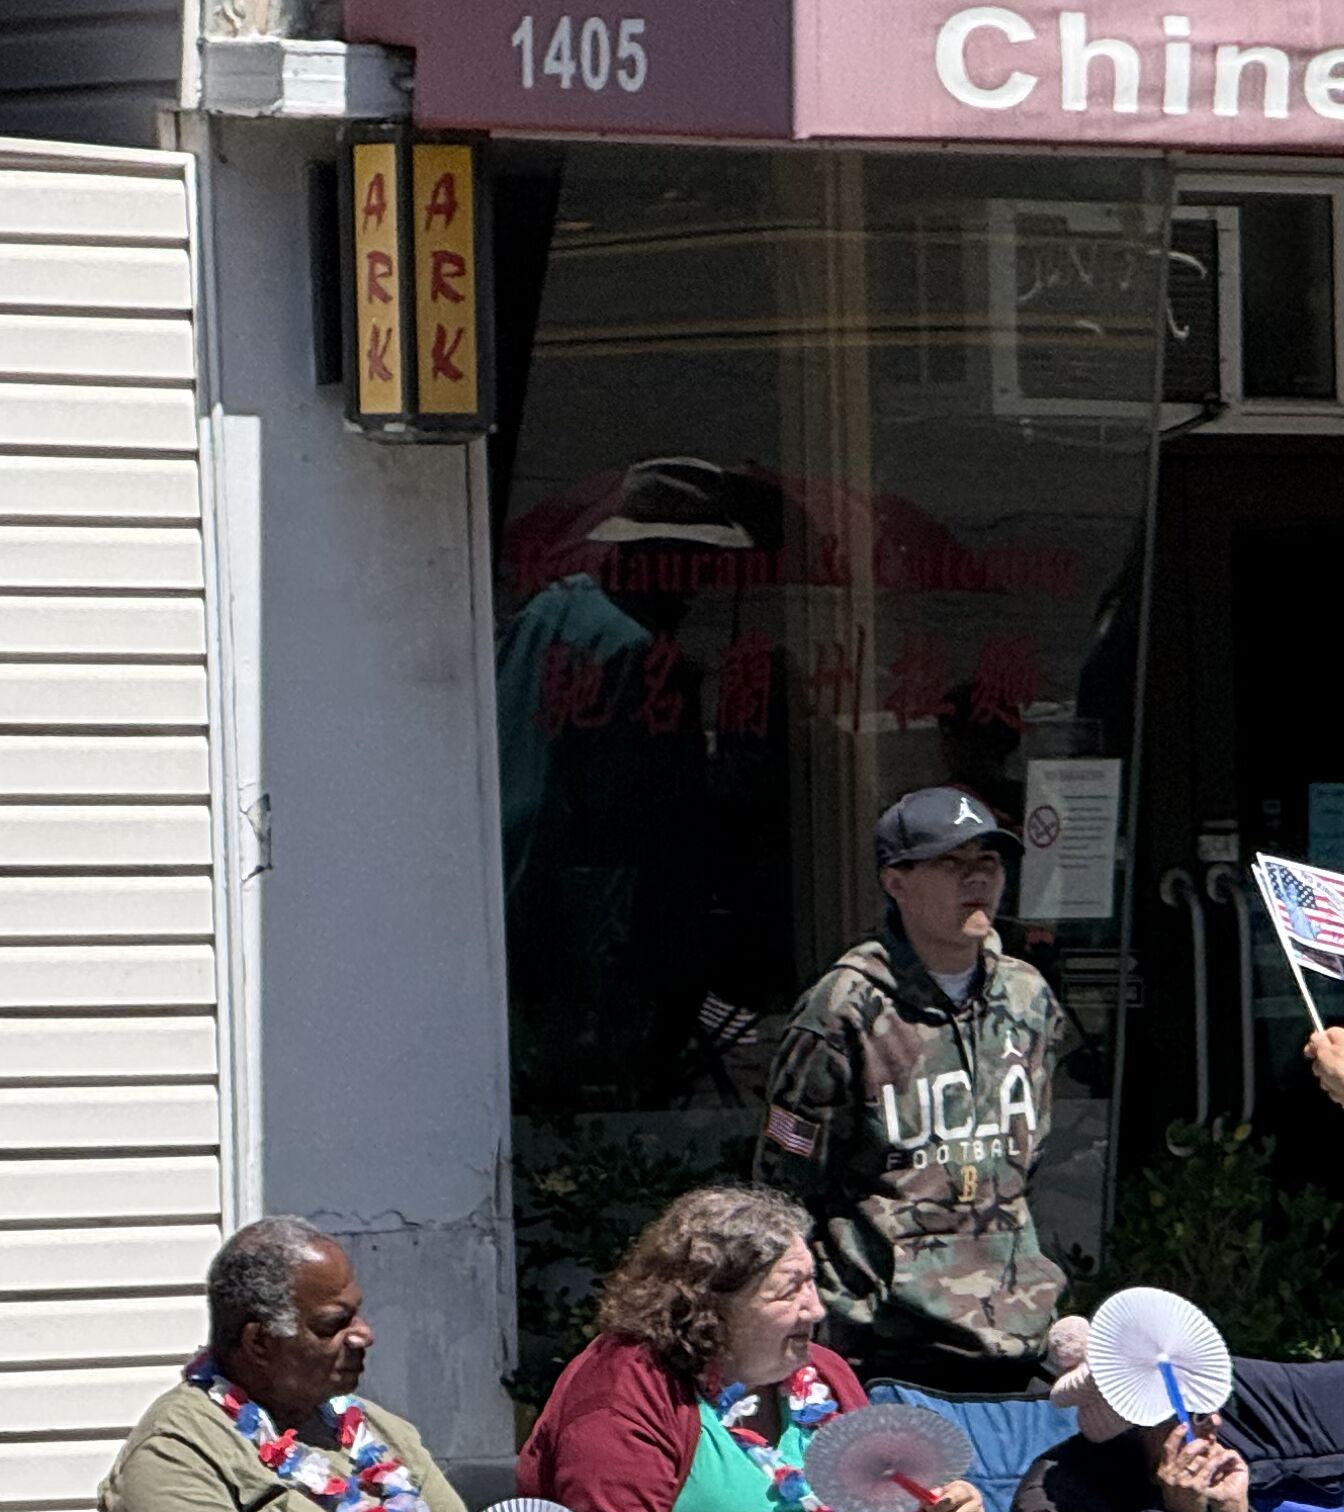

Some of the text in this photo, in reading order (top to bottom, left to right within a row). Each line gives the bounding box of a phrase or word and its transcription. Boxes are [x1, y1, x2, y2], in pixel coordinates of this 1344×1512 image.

[512, 17, 648, 93] 1405
[361, 172, 395, 384] ARK
[424, 172, 468, 383] ARK
